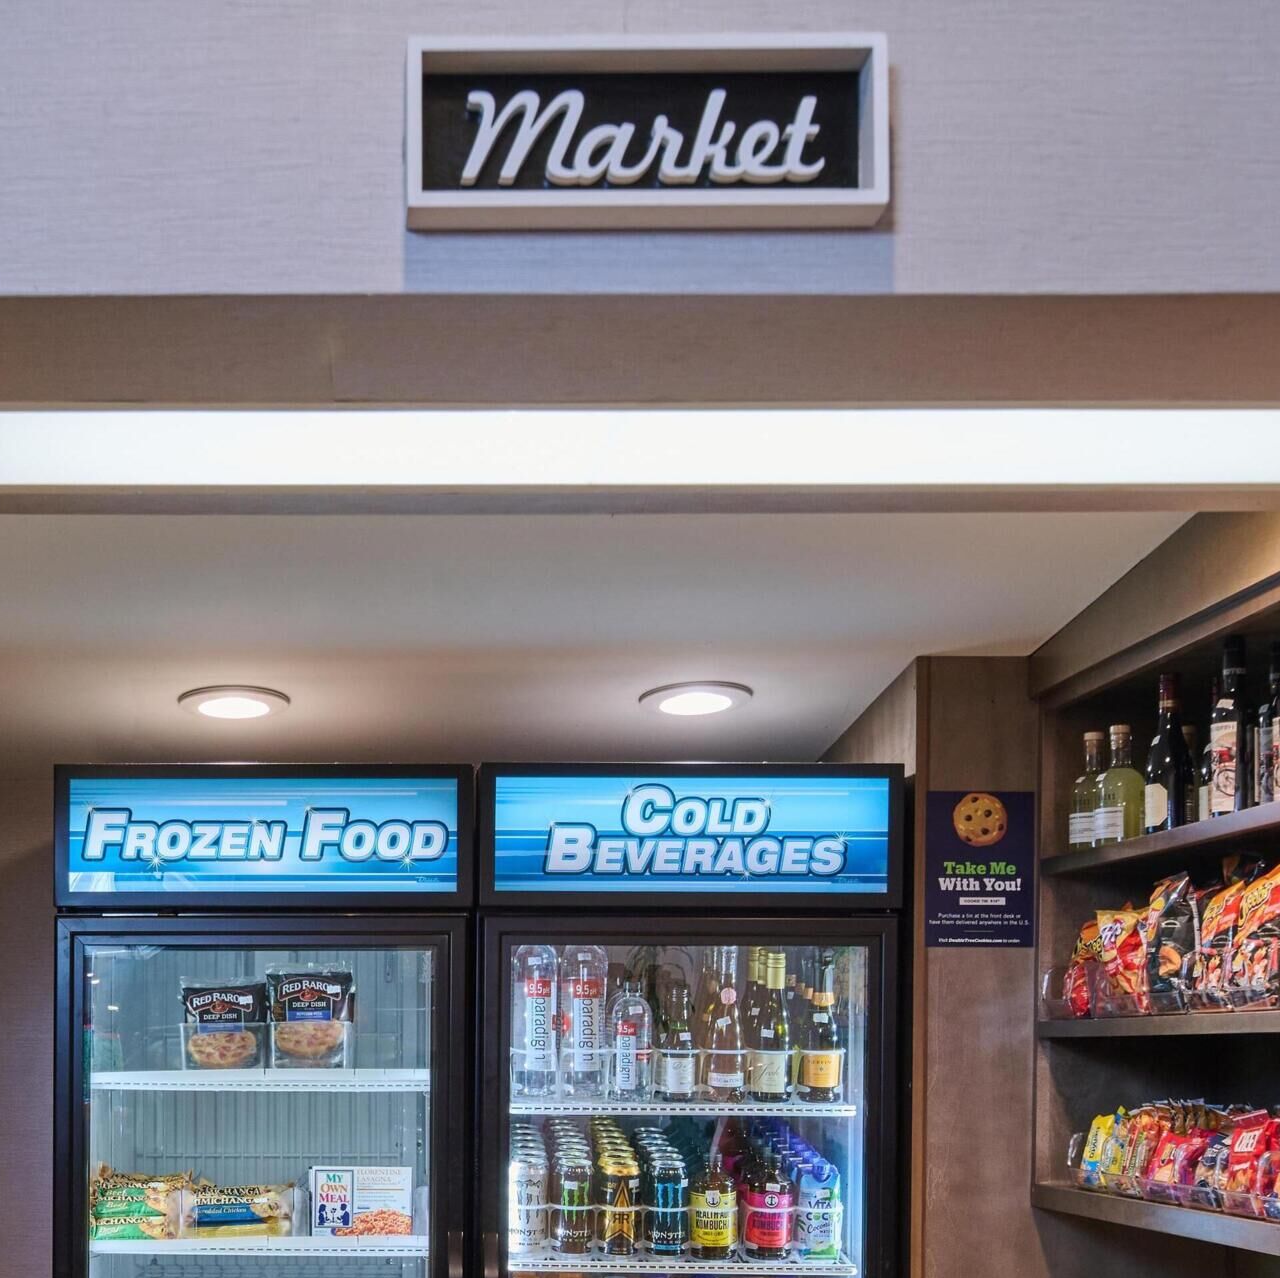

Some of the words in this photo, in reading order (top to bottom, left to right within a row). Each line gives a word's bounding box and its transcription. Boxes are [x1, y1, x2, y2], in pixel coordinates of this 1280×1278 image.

[460, 88, 826, 186] Market
[623, 783, 772, 836] COLD
[82, 808, 287, 861] FROZEN
[300, 807, 450, 862] FOOD
[544, 821, 848, 876] BEVERAGES
[943, 861, 986, 875] Take
[990, 862, 1017, 875] Me
[938, 877, 980, 891] With
[983, 877, 1022, 891] You!
[282, 982, 301, 995] RED
[302, 979, 330, 992] BARO
[192, 995, 211, 1008] RED
[212, 993, 241, 1004] BARO
[203, 1013, 220, 1021] DEEP
[222, 1012, 238, 1020] DISH
[326, 1174, 343, 1183] MY
[320, 1184, 348, 1193] OWN
[319, 1193, 350, 1203] MEAL
